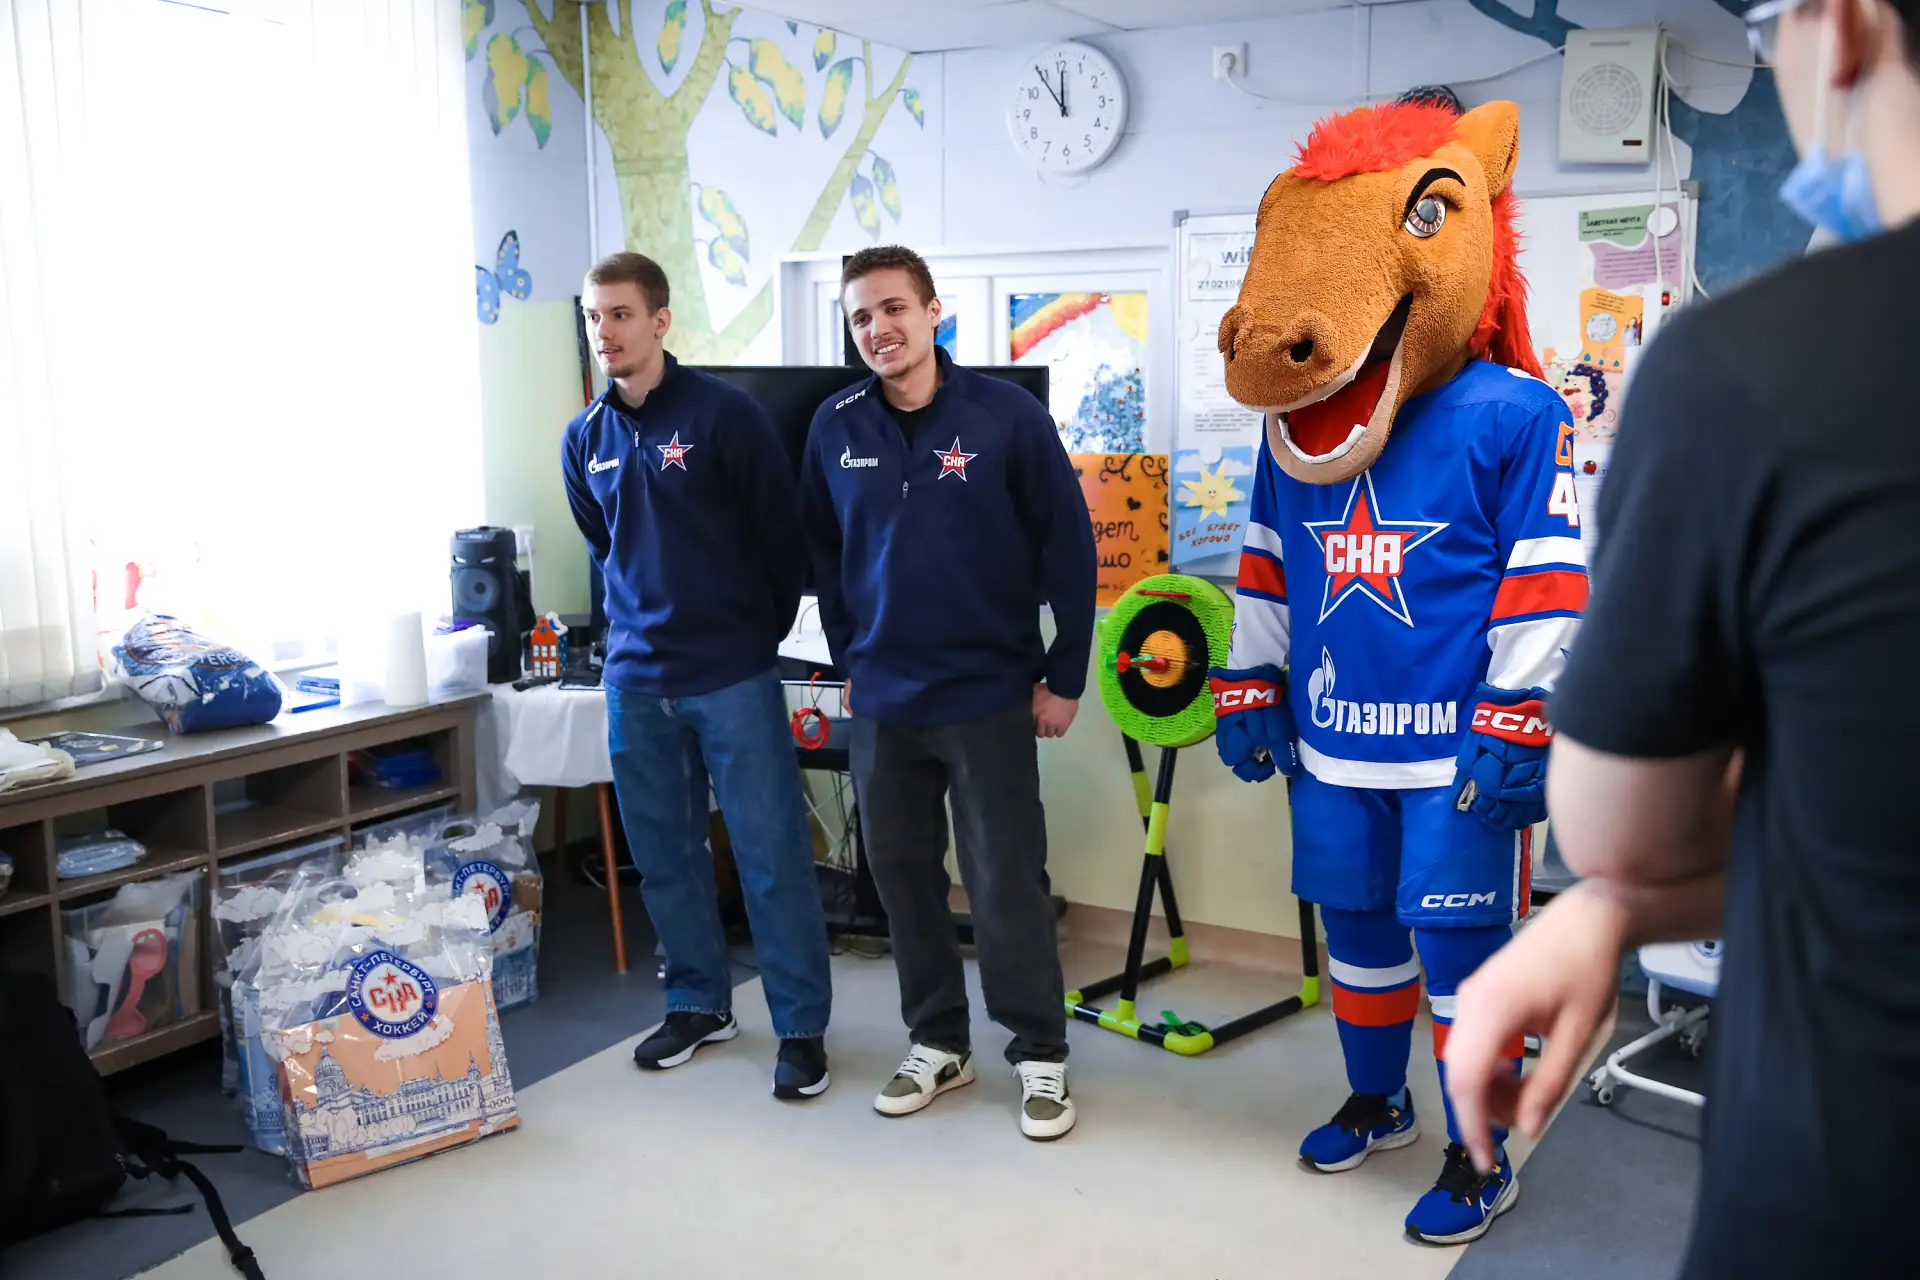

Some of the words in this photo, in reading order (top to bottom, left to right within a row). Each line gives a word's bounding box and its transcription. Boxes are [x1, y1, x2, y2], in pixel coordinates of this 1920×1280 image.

[1056, 60, 1067, 74] 12
[1090, 75, 1098, 88] 2
[1028, 87, 1039, 100] 10
[1098, 95, 1106, 108] 3
[1023, 109, 1031, 122] 9
[1094, 117, 1101, 127] 4
[1030, 127, 1038, 139] 8
[1043, 140, 1051, 153] 7
[1084, 134, 1091, 147] 5
[1062, 143, 1071, 157] 6
[835, 389, 866, 410] CCM
[943, 455, 966, 467] СКА
[1093, 520, 1140, 545] дет
[1326, 534, 1402, 574] СКА
[1334, 700, 1457, 735] ГАЗПРОМ
[1471, 709, 1554, 737] CCM
[1420, 891, 1497, 908] CCM
[350, 953, 434, 1007] САНКТ-ПЕТЕРБУРГ
[369, 982, 419, 1013] СКА
[373, 1011, 428, 1035] ХОККЕЙ
